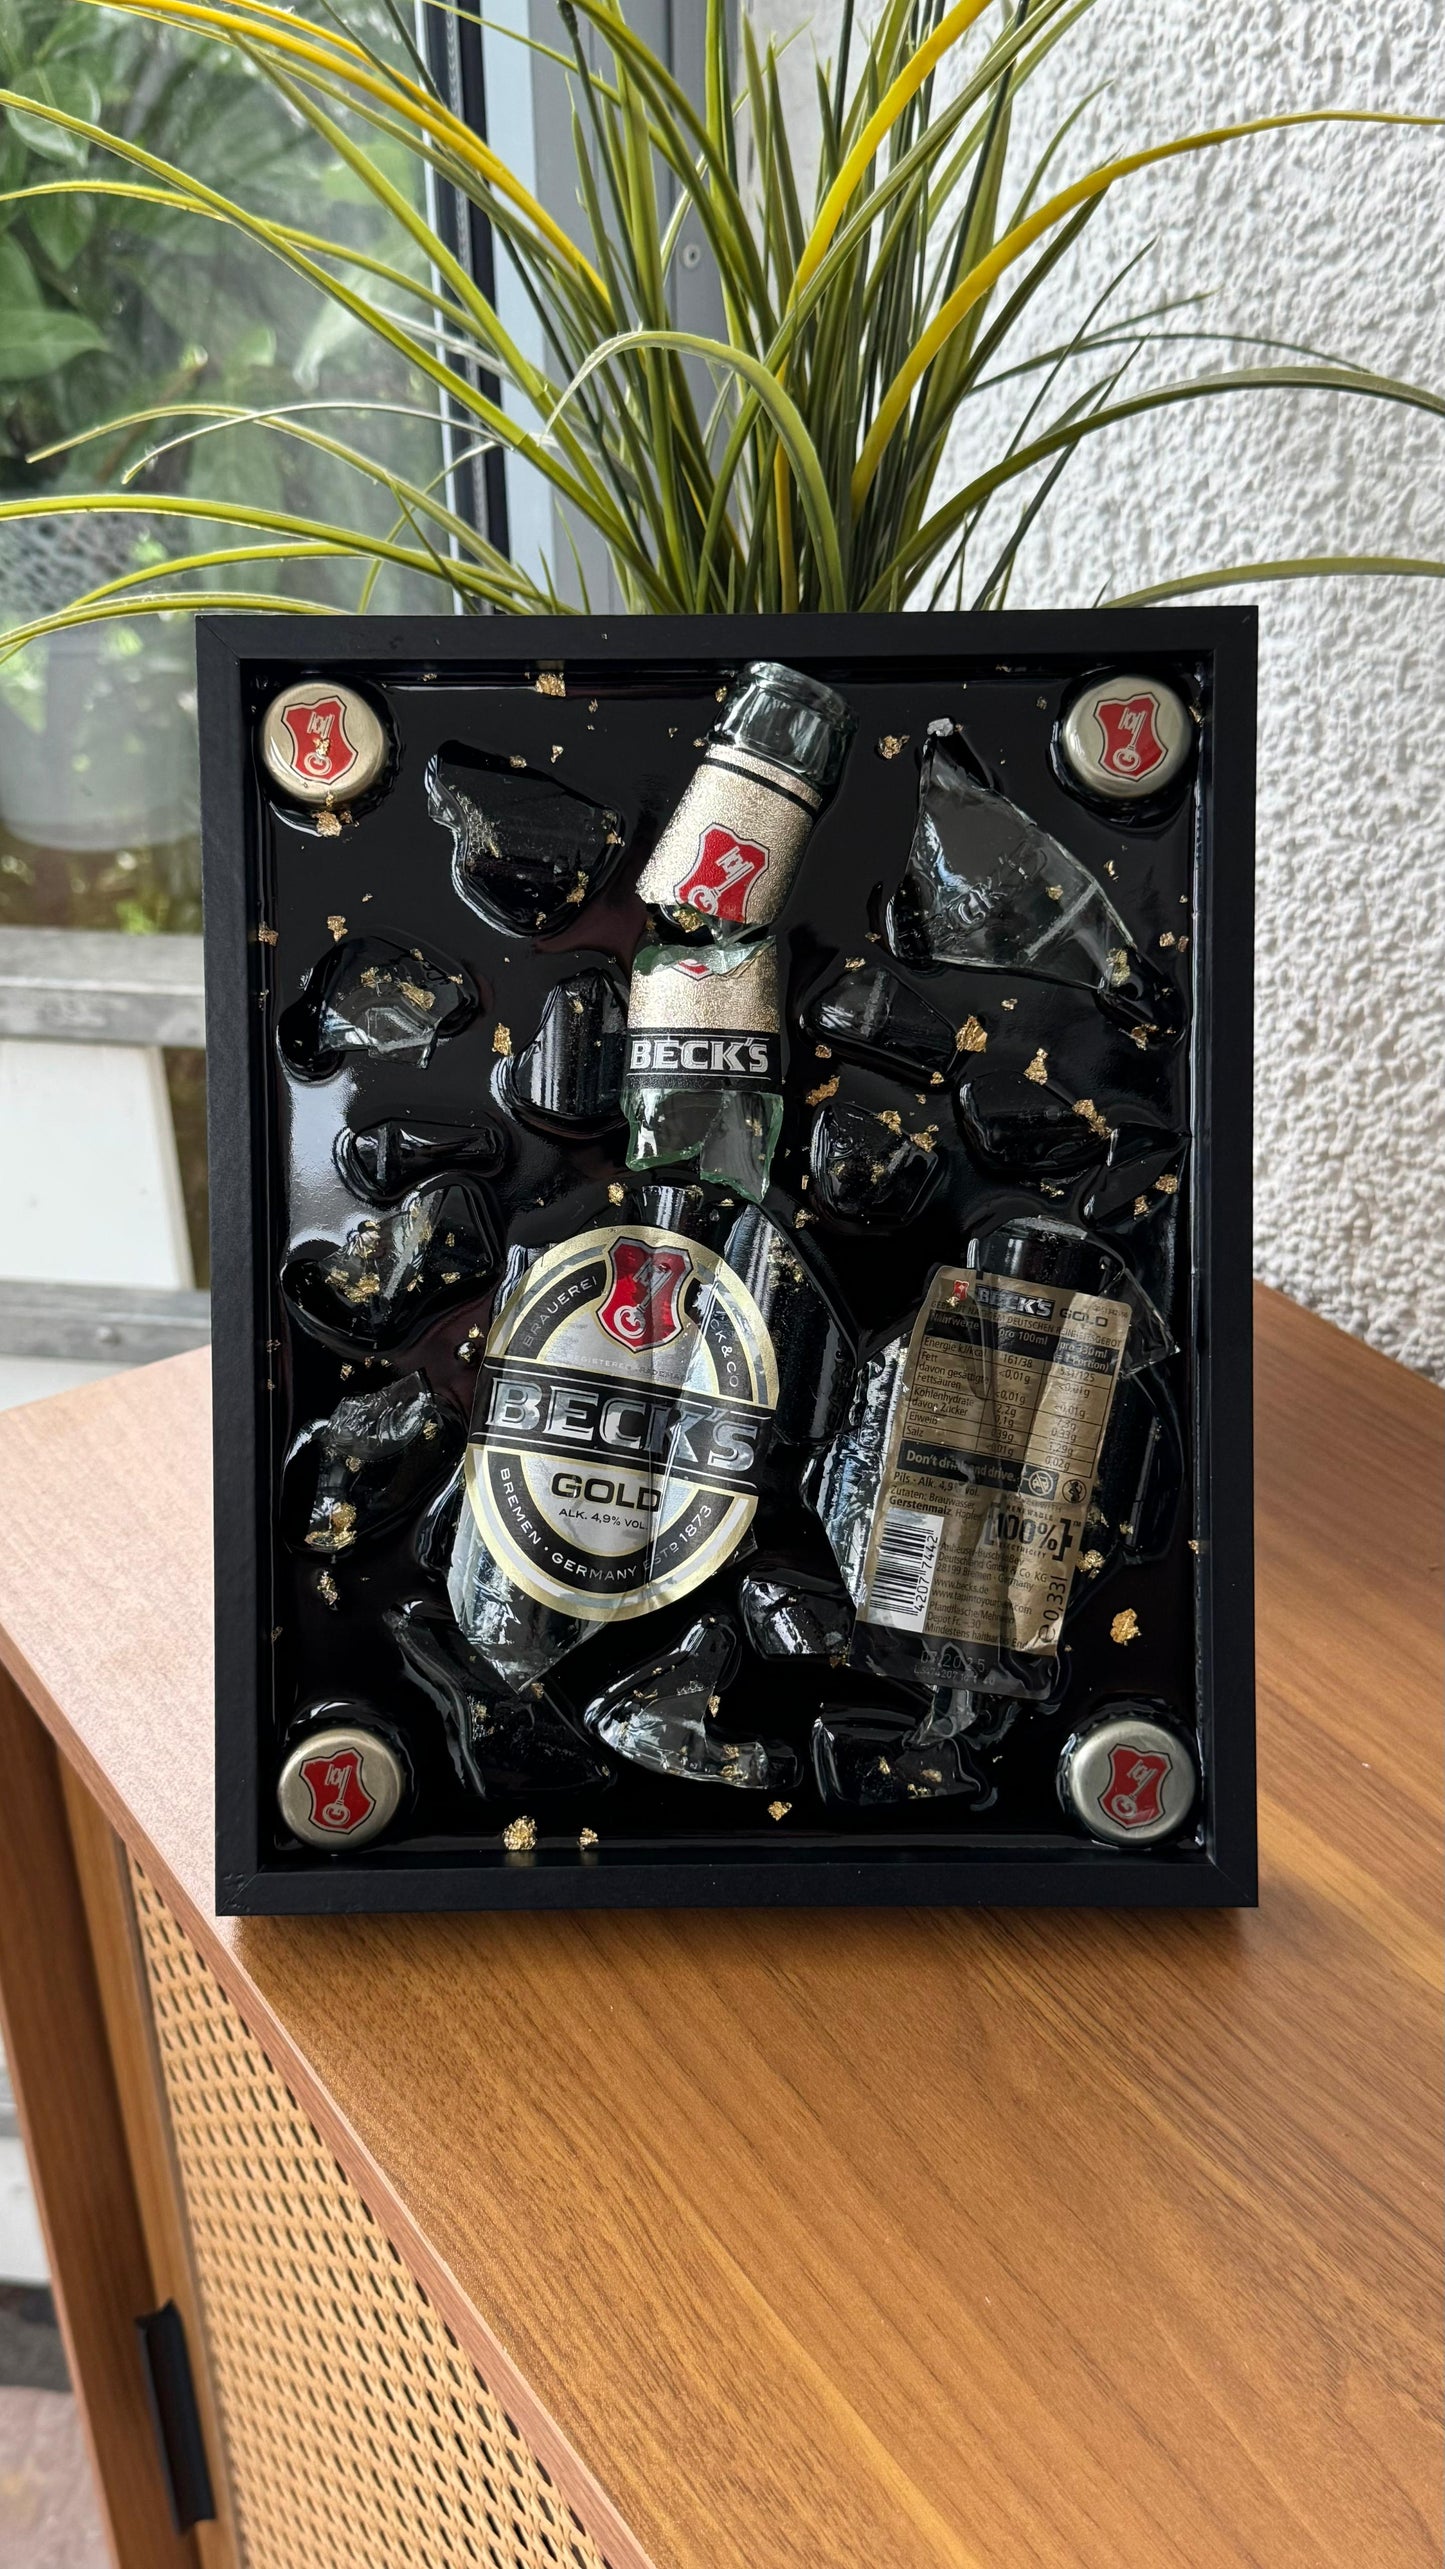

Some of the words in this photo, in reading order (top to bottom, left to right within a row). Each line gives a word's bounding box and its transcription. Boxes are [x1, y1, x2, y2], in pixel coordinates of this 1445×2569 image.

[630, 1037, 769, 1073] BECK'S
[523, 1276, 597, 1348] BRAUEREI
[998, 1328, 1015, 1342] pro
[721, 1345, 733, 1358] &
[924, 1337, 956, 1351] Energie
[922, 1351, 938, 1362] Fett
[1003, 1353, 1033, 1369] 161/38
[919, 1362, 946, 1376] davon
[917, 1373, 962, 1389] Fettsäuren
[914, 1386, 975, 1406] Kohlenhydrate
[911, 1398, 938, 1412] davon
[940, 1402, 969, 1417] Zucker
[485, 1377, 759, 1472] BECK'S
[909, 1411, 939, 1425] Eiweiß
[906, 1425, 924, 1438] Salz
[906, 1449, 938, 1467] Don't
[987, 1465, 1016, 1482] drive.
[894, 1470, 911, 1484] Pils
[918, 1476, 936, 1489] Alk.
[938, 1480, 960, 1492] 4,9
[551, 1472, 662, 1513] GOLD
[890, 1484, 928, 1500] Zutaten:
[500, 1467, 542, 1546] BREMEN
[551, 1552, 637, 1582] GERMANY
[679, 1504, 712, 1543] 1873
[558, 1507, 588, 1521] ALK.
[590, 1512, 621, 1527] 4,9%
[624, 1518, 649, 1531] VOL.
[936, 1562, 961, 1576] 28199
[1034, 1572, 1048, 1583] KG
[928, 1611, 952, 1625] Depot
[925, 1622, 970, 1639] Mindestens
